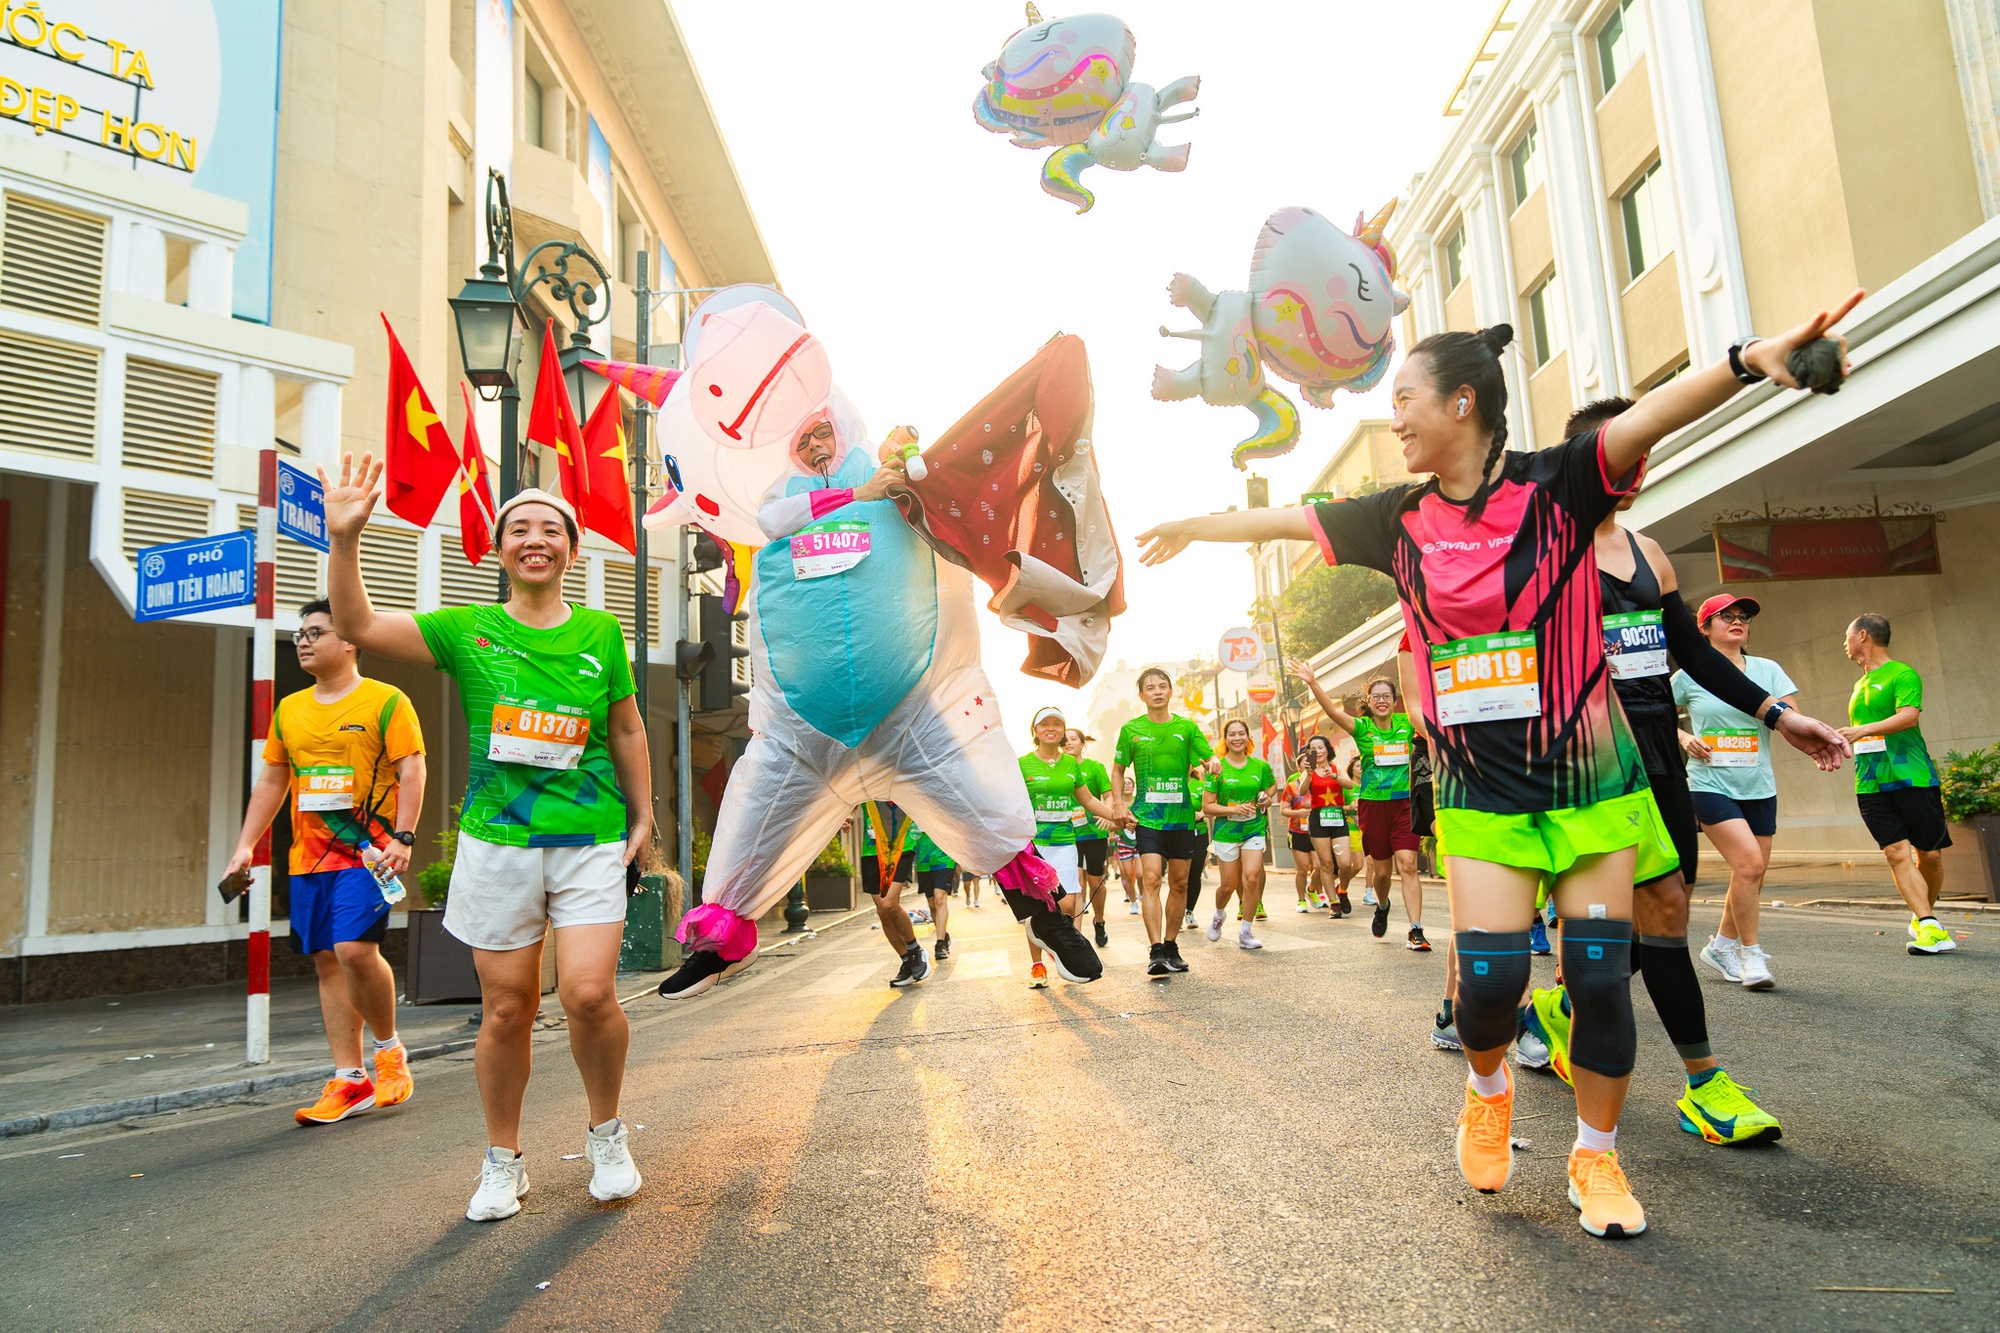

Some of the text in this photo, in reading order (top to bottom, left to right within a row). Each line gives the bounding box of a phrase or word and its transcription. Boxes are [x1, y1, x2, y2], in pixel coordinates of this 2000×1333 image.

[107, 39, 154, 89] TA
[0, 75, 197, 172] ĐẸP HƠN
[310, 489, 325, 505] PH
[281, 498, 322, 539] TRÀNG
[813, 532, 870, 551] 51407 M
[187, 542, 225, 566] PHỐ
[147, 581, 174, 609] ĐINH
[206, 567, 245, 599] HOÀNG
[1621, 624, 1659, 648] 90377
[1456, 650, 1523, 683] 60819
[1525, 657, 1534, 669] F
[518, 710, 587, 738] 61376 F
[1717, 736, 1752, 749] 60265
[310, 775, 345, 790] 60725
[1156, 781, 1179, 791] 81963
